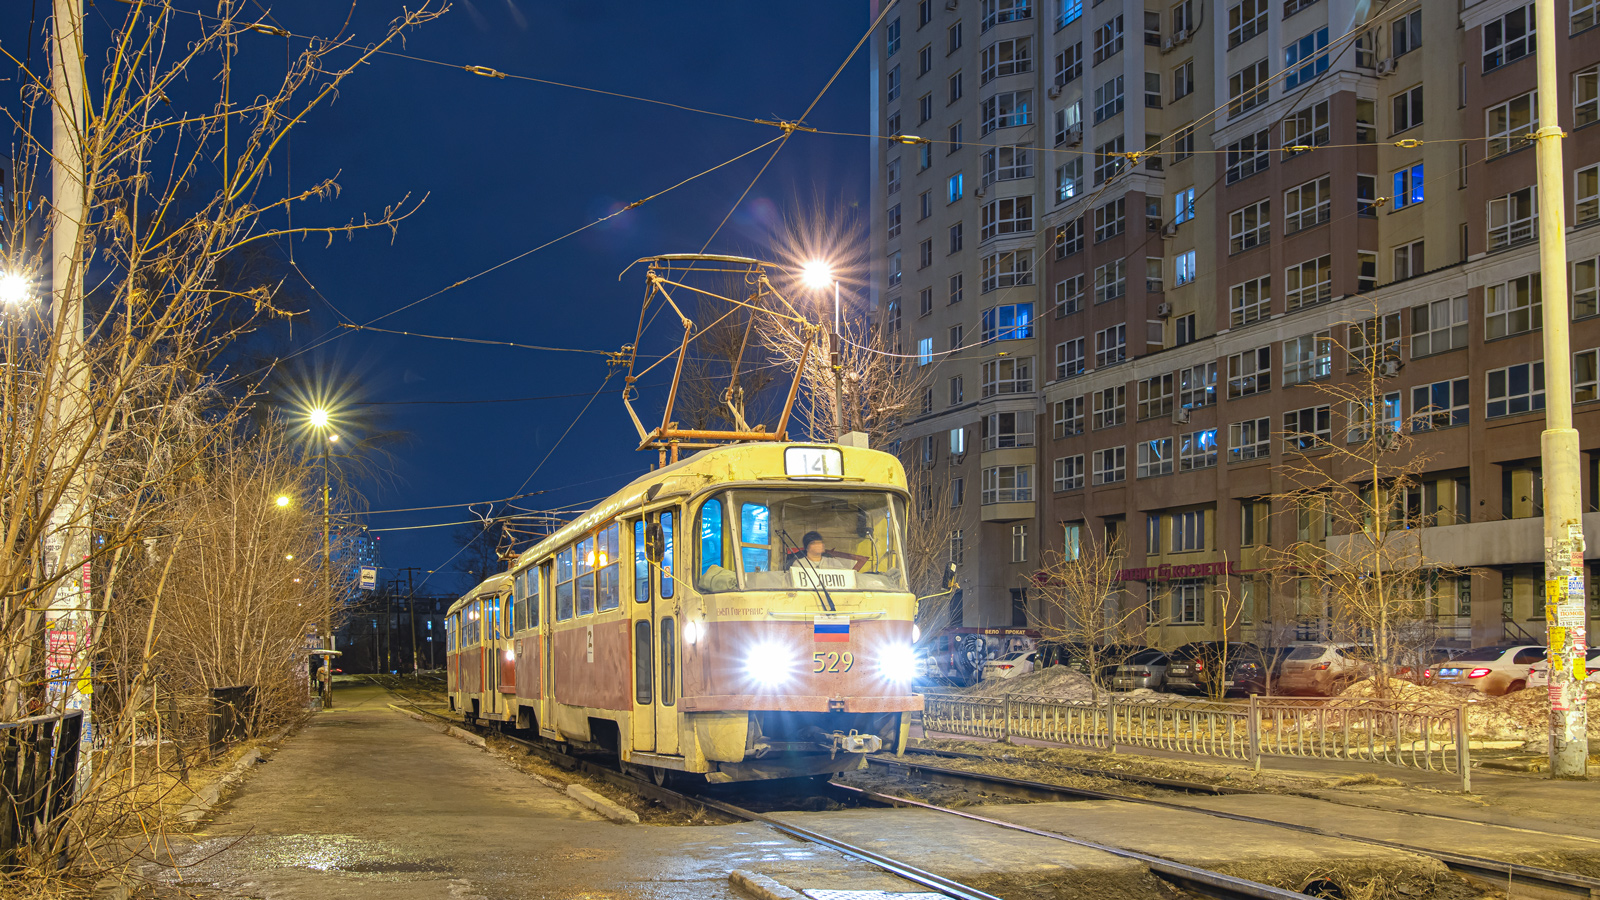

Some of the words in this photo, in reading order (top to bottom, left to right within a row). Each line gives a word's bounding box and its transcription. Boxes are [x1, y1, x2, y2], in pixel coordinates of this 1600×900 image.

[802, 454, 829, 479] 14
[1172, 560, 1235, 578] КОСМЕТИК
[798, 571, 808, 588] В
[812, 651, 855, 673] 529
